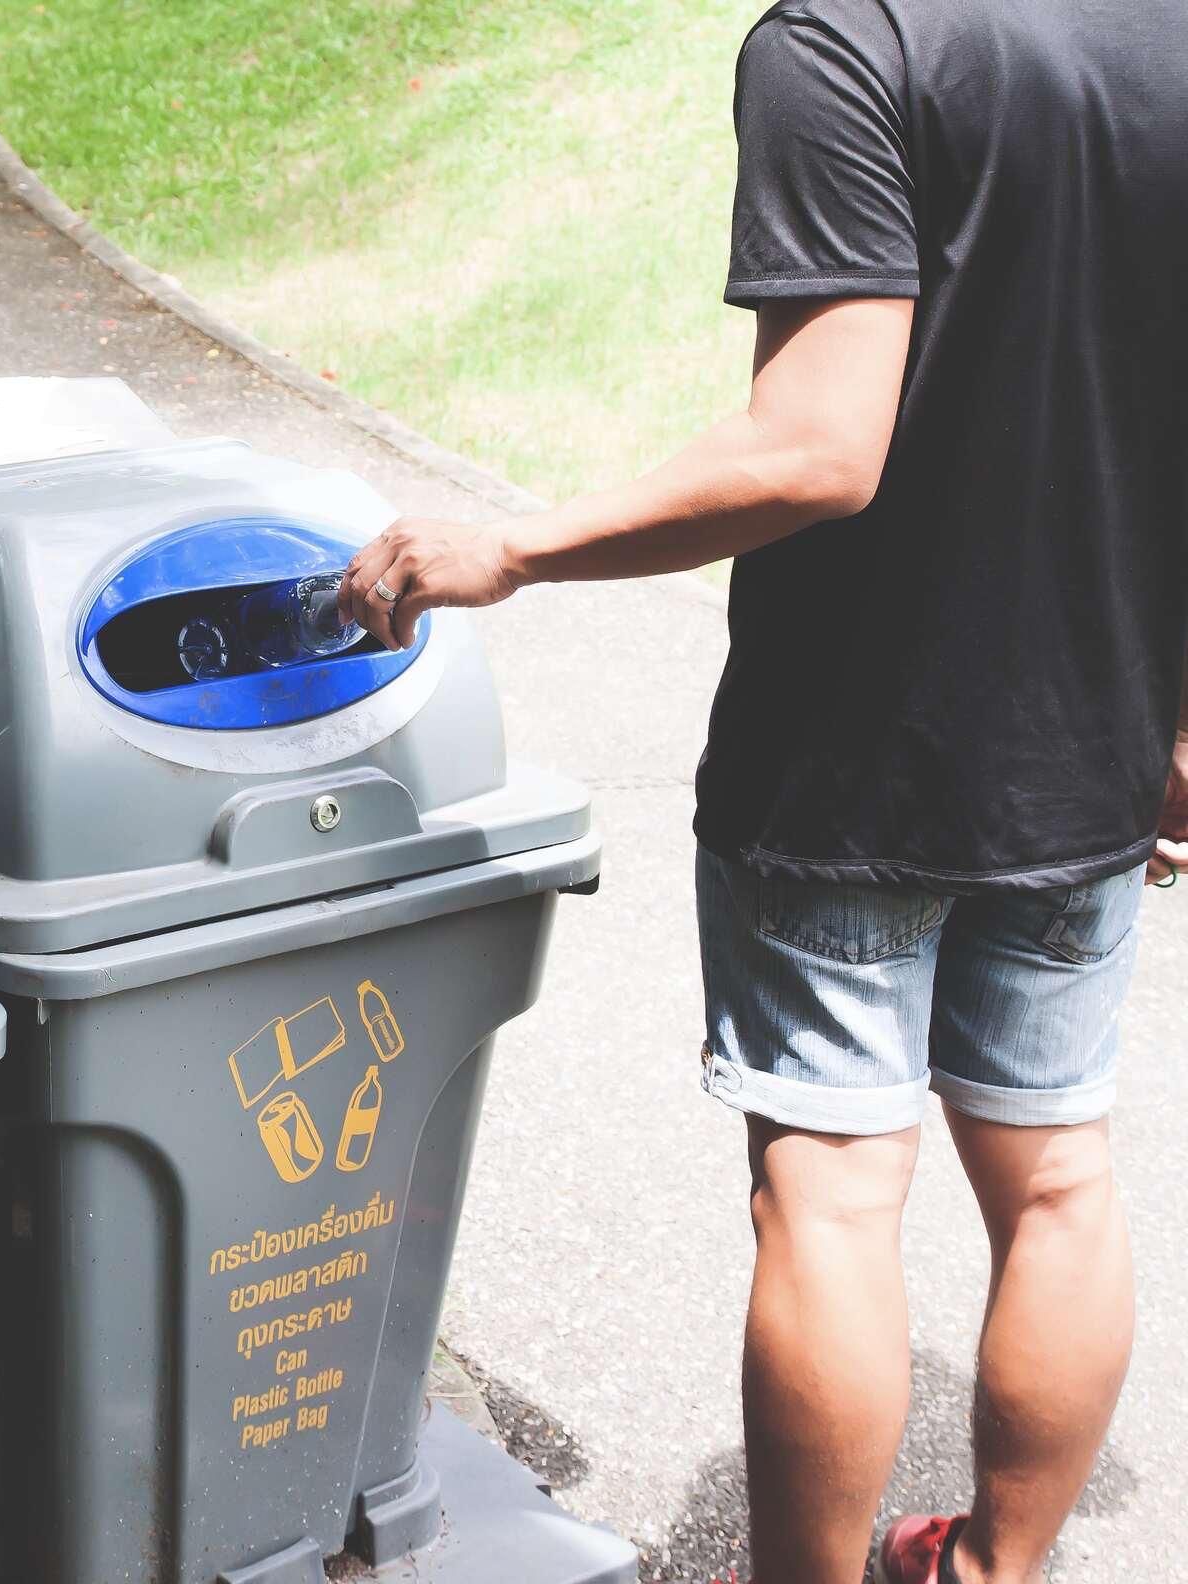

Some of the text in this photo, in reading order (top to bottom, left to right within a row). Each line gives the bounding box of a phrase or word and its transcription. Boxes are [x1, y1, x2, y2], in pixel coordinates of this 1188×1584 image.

[228, 1250, 367, 1312] ขวดพลาสติก
[237, 1297, 353, 1360] ถุงกระดาษ
[275, 1349, 308, 1375] Can
[232, 1369, 343, 1421] Plastic Bottle
[241, 1404, 328, 1449] Paper Bag
